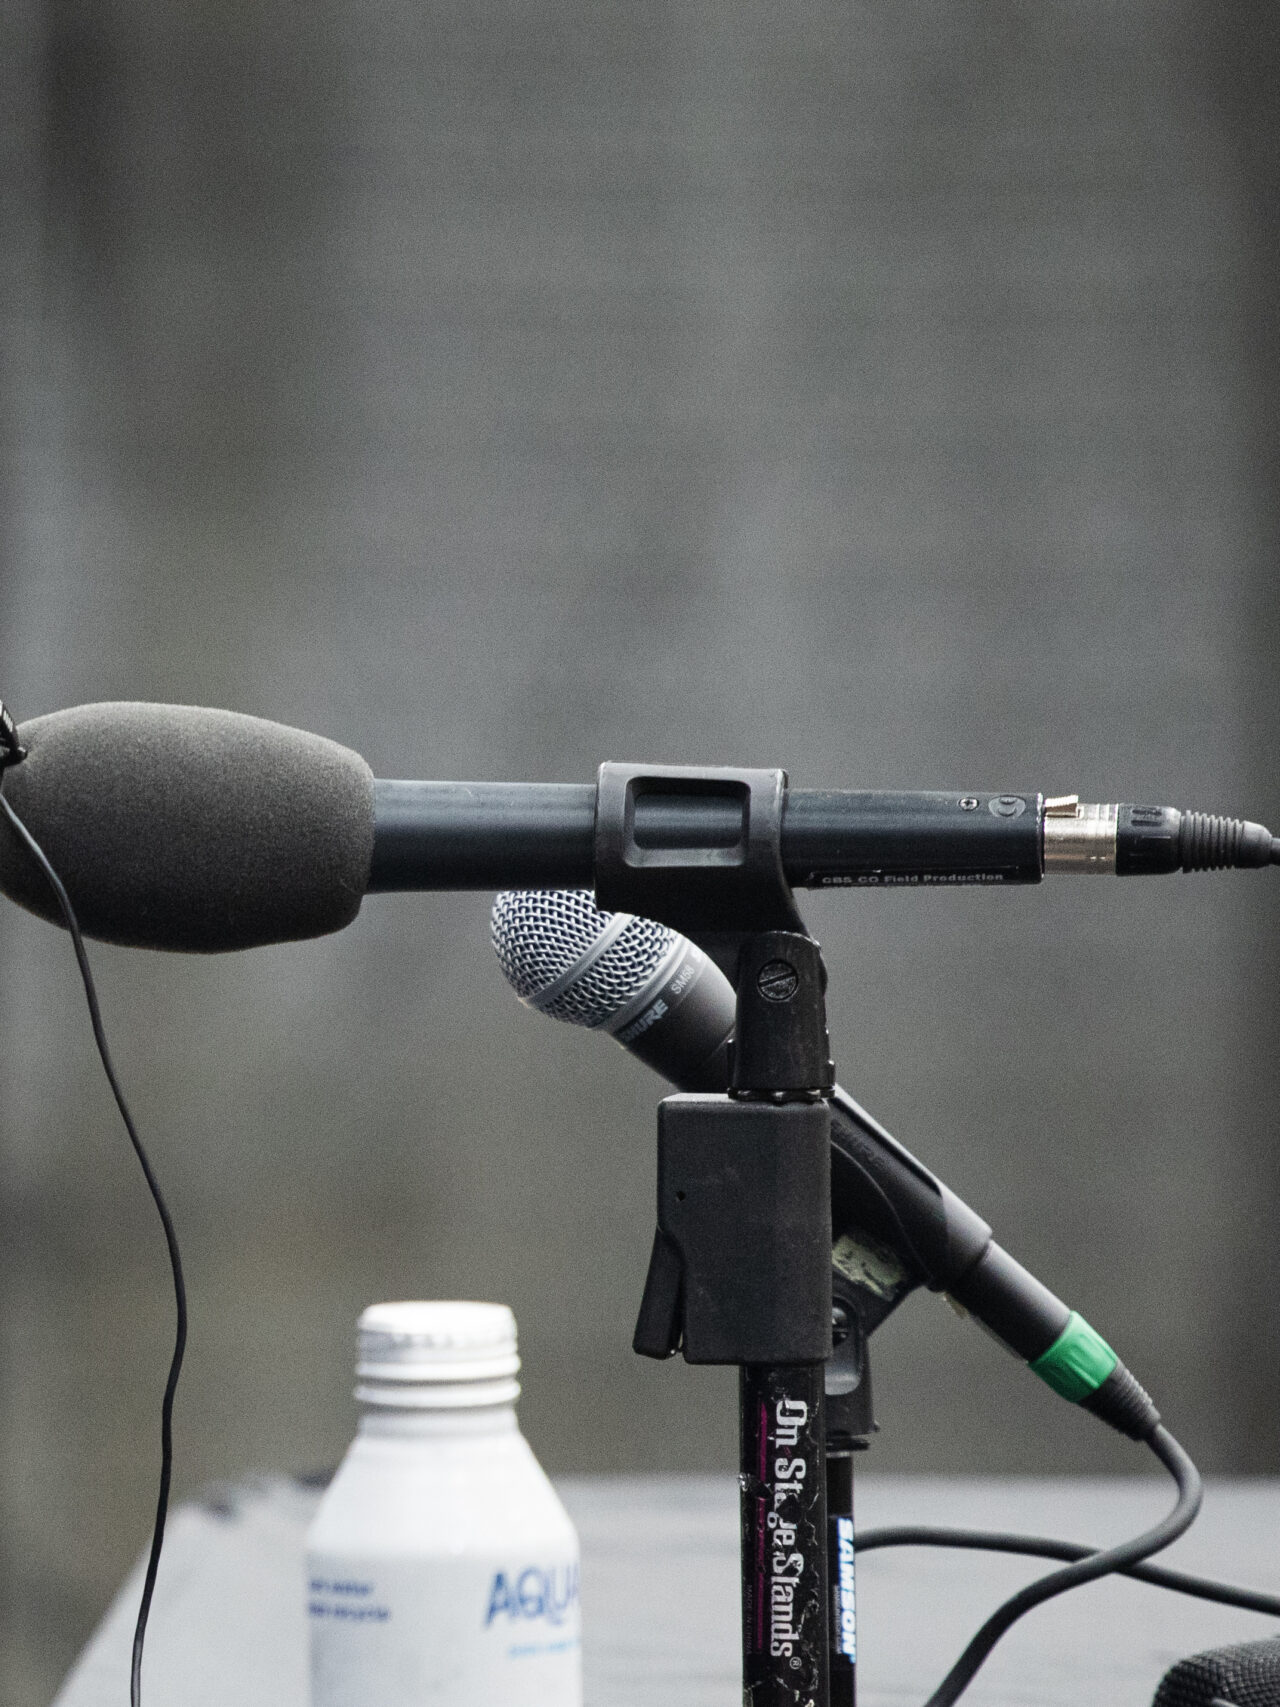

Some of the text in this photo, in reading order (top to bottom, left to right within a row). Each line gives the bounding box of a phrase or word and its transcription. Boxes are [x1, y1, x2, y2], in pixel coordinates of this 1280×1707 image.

[821, 875, 853, 884] CBS
[884, 874, 919, 884] Field
[923, 872, 1004, 882] Production
[671, 964, 695, 995] SM58
[621, 999, 669, 1041] SHURE
[775, 1399, 808, 1449] On
[837, 1517, 857, 1658] SAMSON
